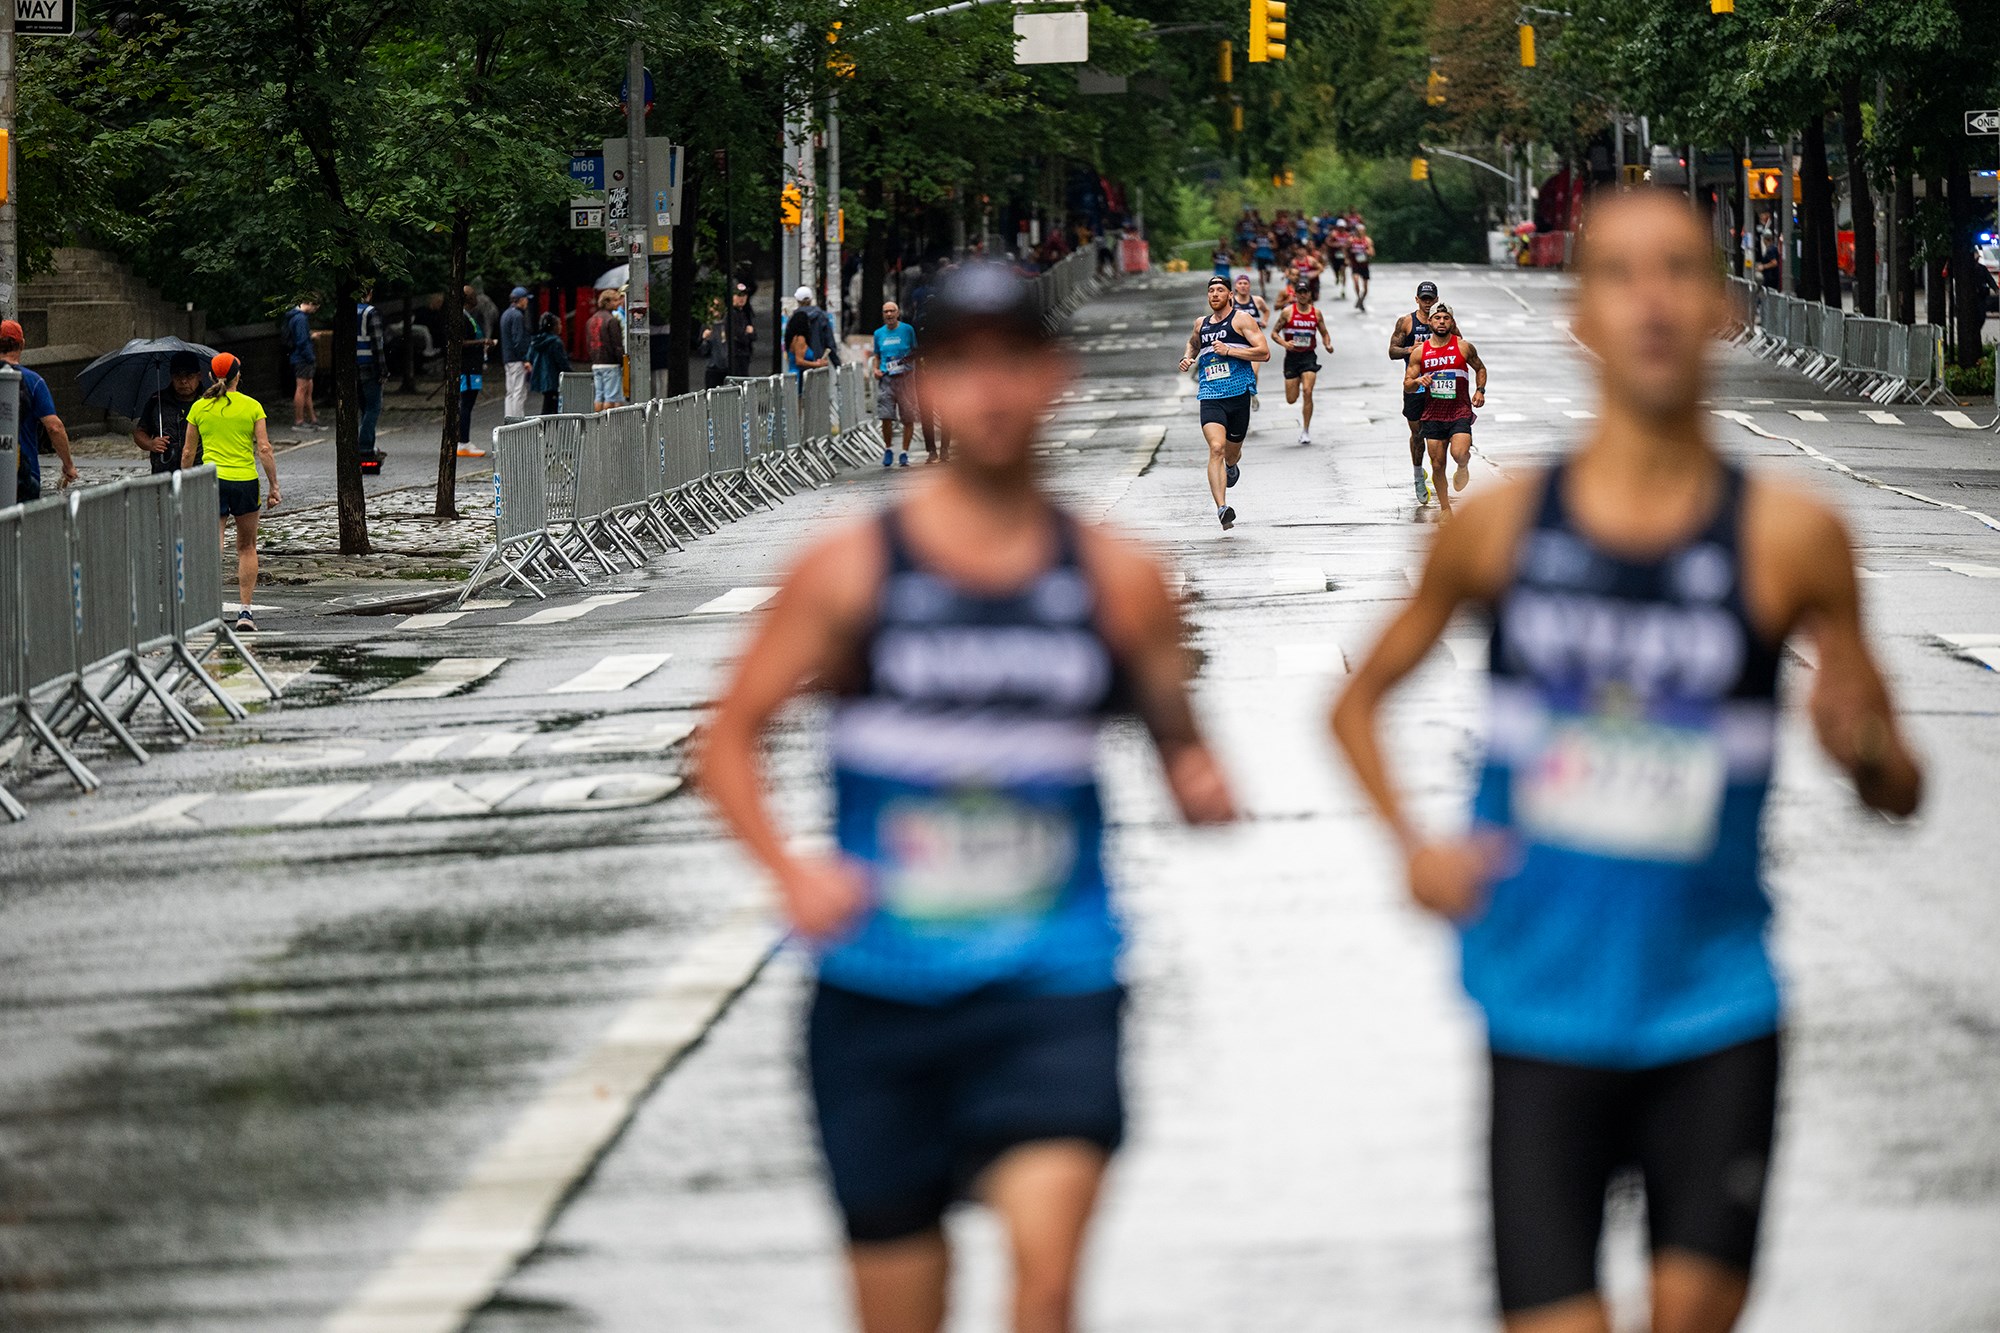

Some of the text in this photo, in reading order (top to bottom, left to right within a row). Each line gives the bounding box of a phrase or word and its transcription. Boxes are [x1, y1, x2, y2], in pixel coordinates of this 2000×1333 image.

[16, 0, 57, 19] WAY
[1977, 118, 1996, 128] ONE
[573, 160, 595, 172] M66
[577, 176, 595, 188] 72
[1424, 355, 1457, 369] FDNY
[1210, 363, 1228, 375] 1741
[1436, 380, 1454, 389] 1743
[494, 474, 503, 517] NYPD
